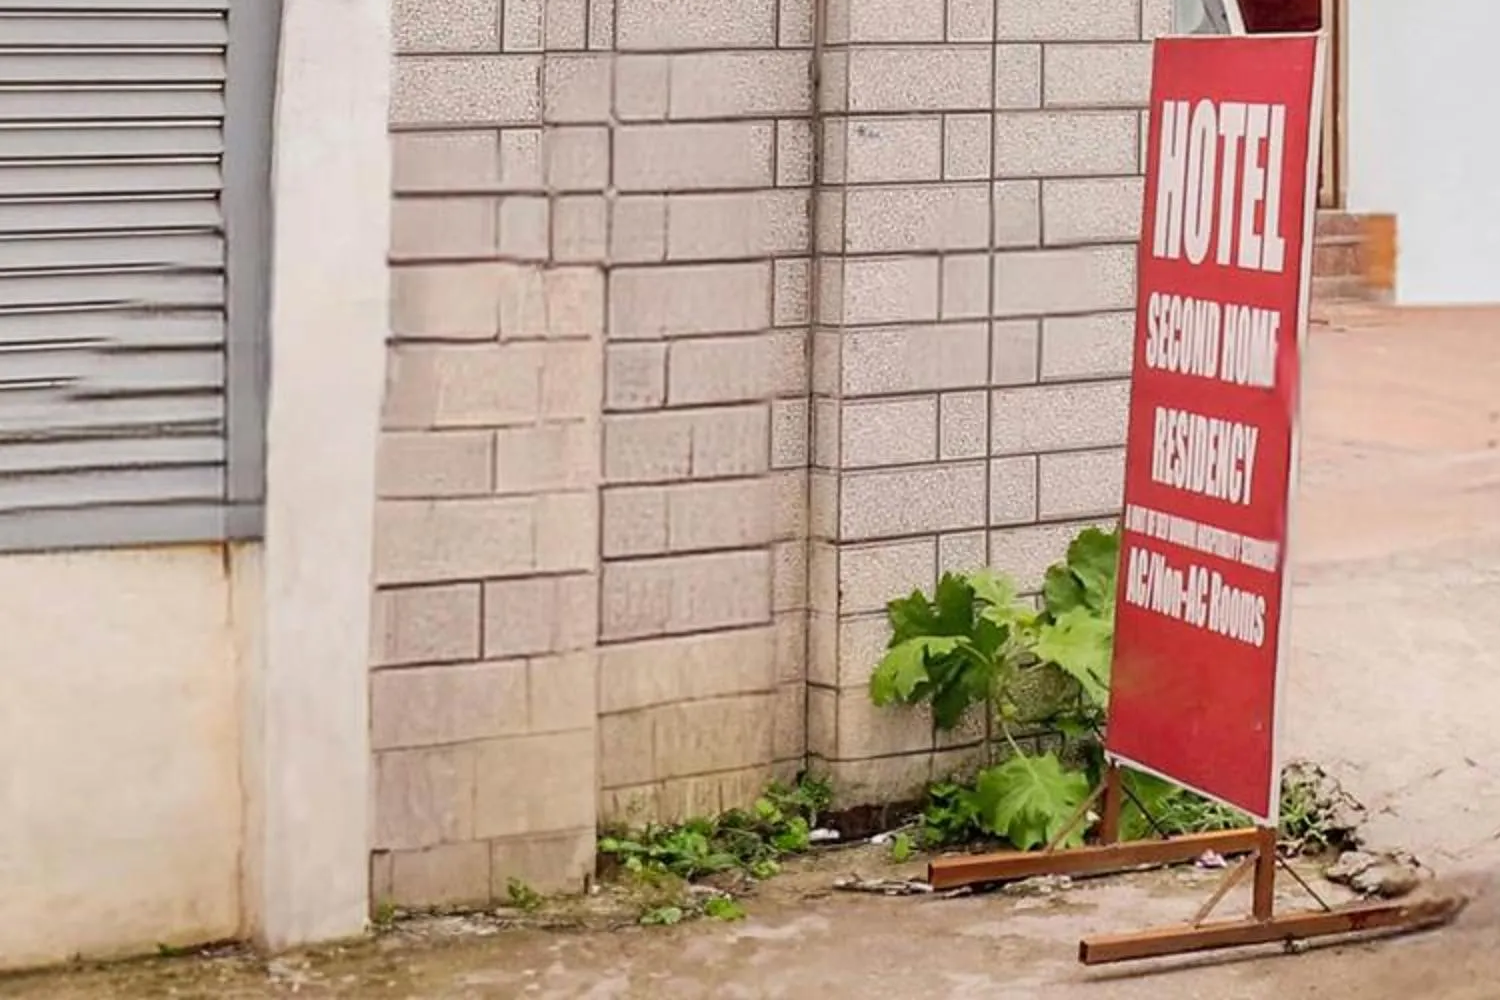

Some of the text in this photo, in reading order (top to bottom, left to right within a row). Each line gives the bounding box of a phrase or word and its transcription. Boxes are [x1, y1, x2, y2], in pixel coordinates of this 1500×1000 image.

[1152, 98, 1287, 273] HOTEL
[1146, 291, 1281, 388] SECOND HOME
[1151, 405, 1259, 505] RESIDENCY
